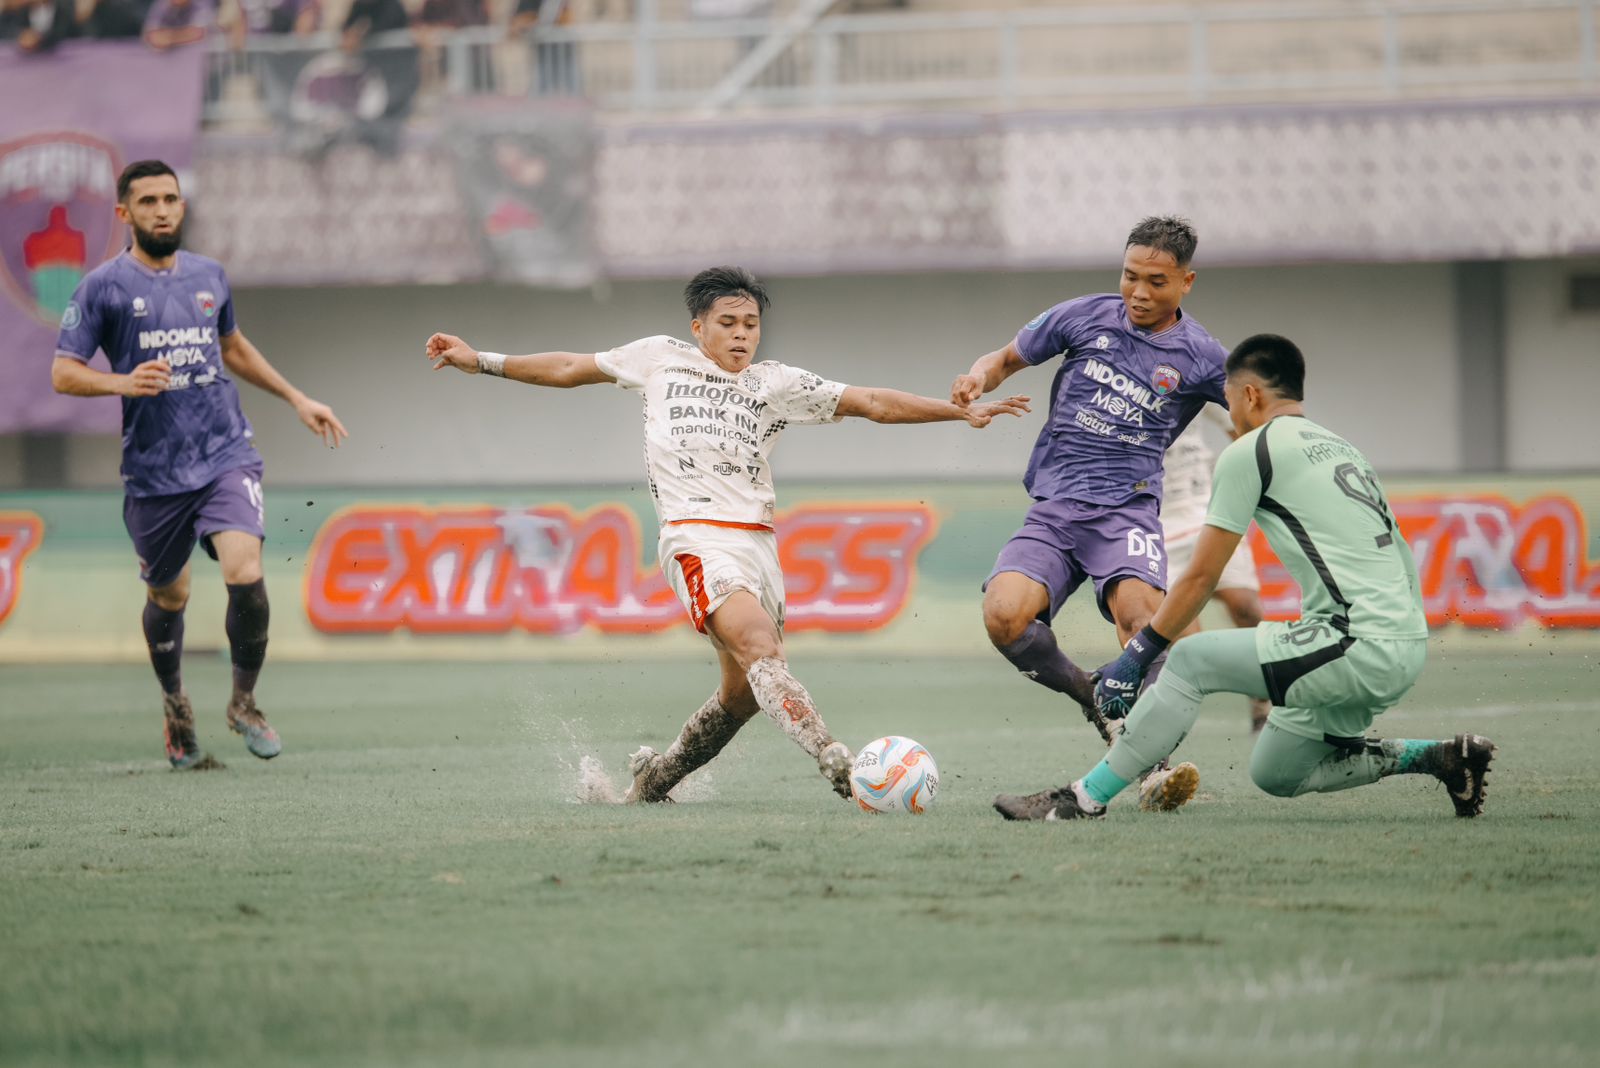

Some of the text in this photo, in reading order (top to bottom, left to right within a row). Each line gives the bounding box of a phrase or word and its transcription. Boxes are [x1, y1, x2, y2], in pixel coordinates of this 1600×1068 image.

[139, 327, 213, 349] INDOMILK
[157, 347, 207, 368] MOYA
[1083, 358, 1167, 414] INDOMILK
[670, 406, 728, 423] BANK
[1090, 387, 1143, 427] MOYA
[1075, 411, 1117, 436] matrix
[1128, 528, 1161, 561] 66
